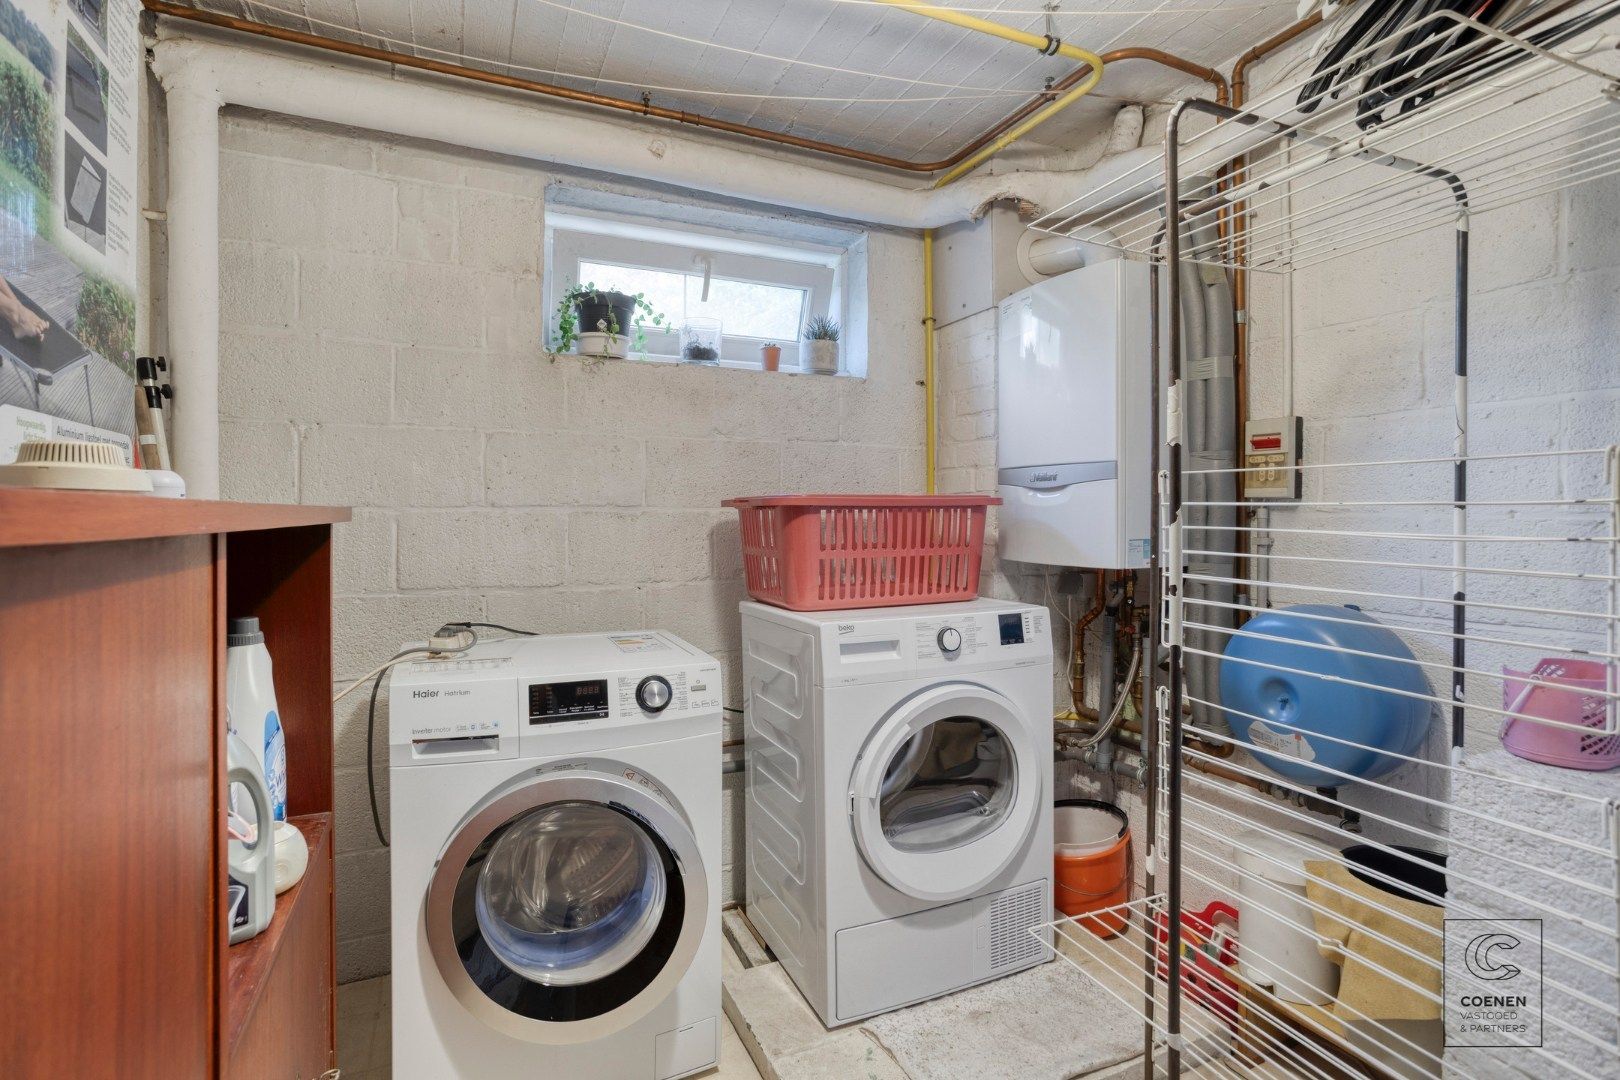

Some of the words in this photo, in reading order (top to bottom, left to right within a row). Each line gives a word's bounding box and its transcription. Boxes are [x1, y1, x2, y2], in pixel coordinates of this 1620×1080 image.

[57, 425, 83, 439] Aluminium
[1034, 472, 1058, 482] Vaillant
[838, 624, 854, 632] beko
[413, 689, 440, 698] Haier
